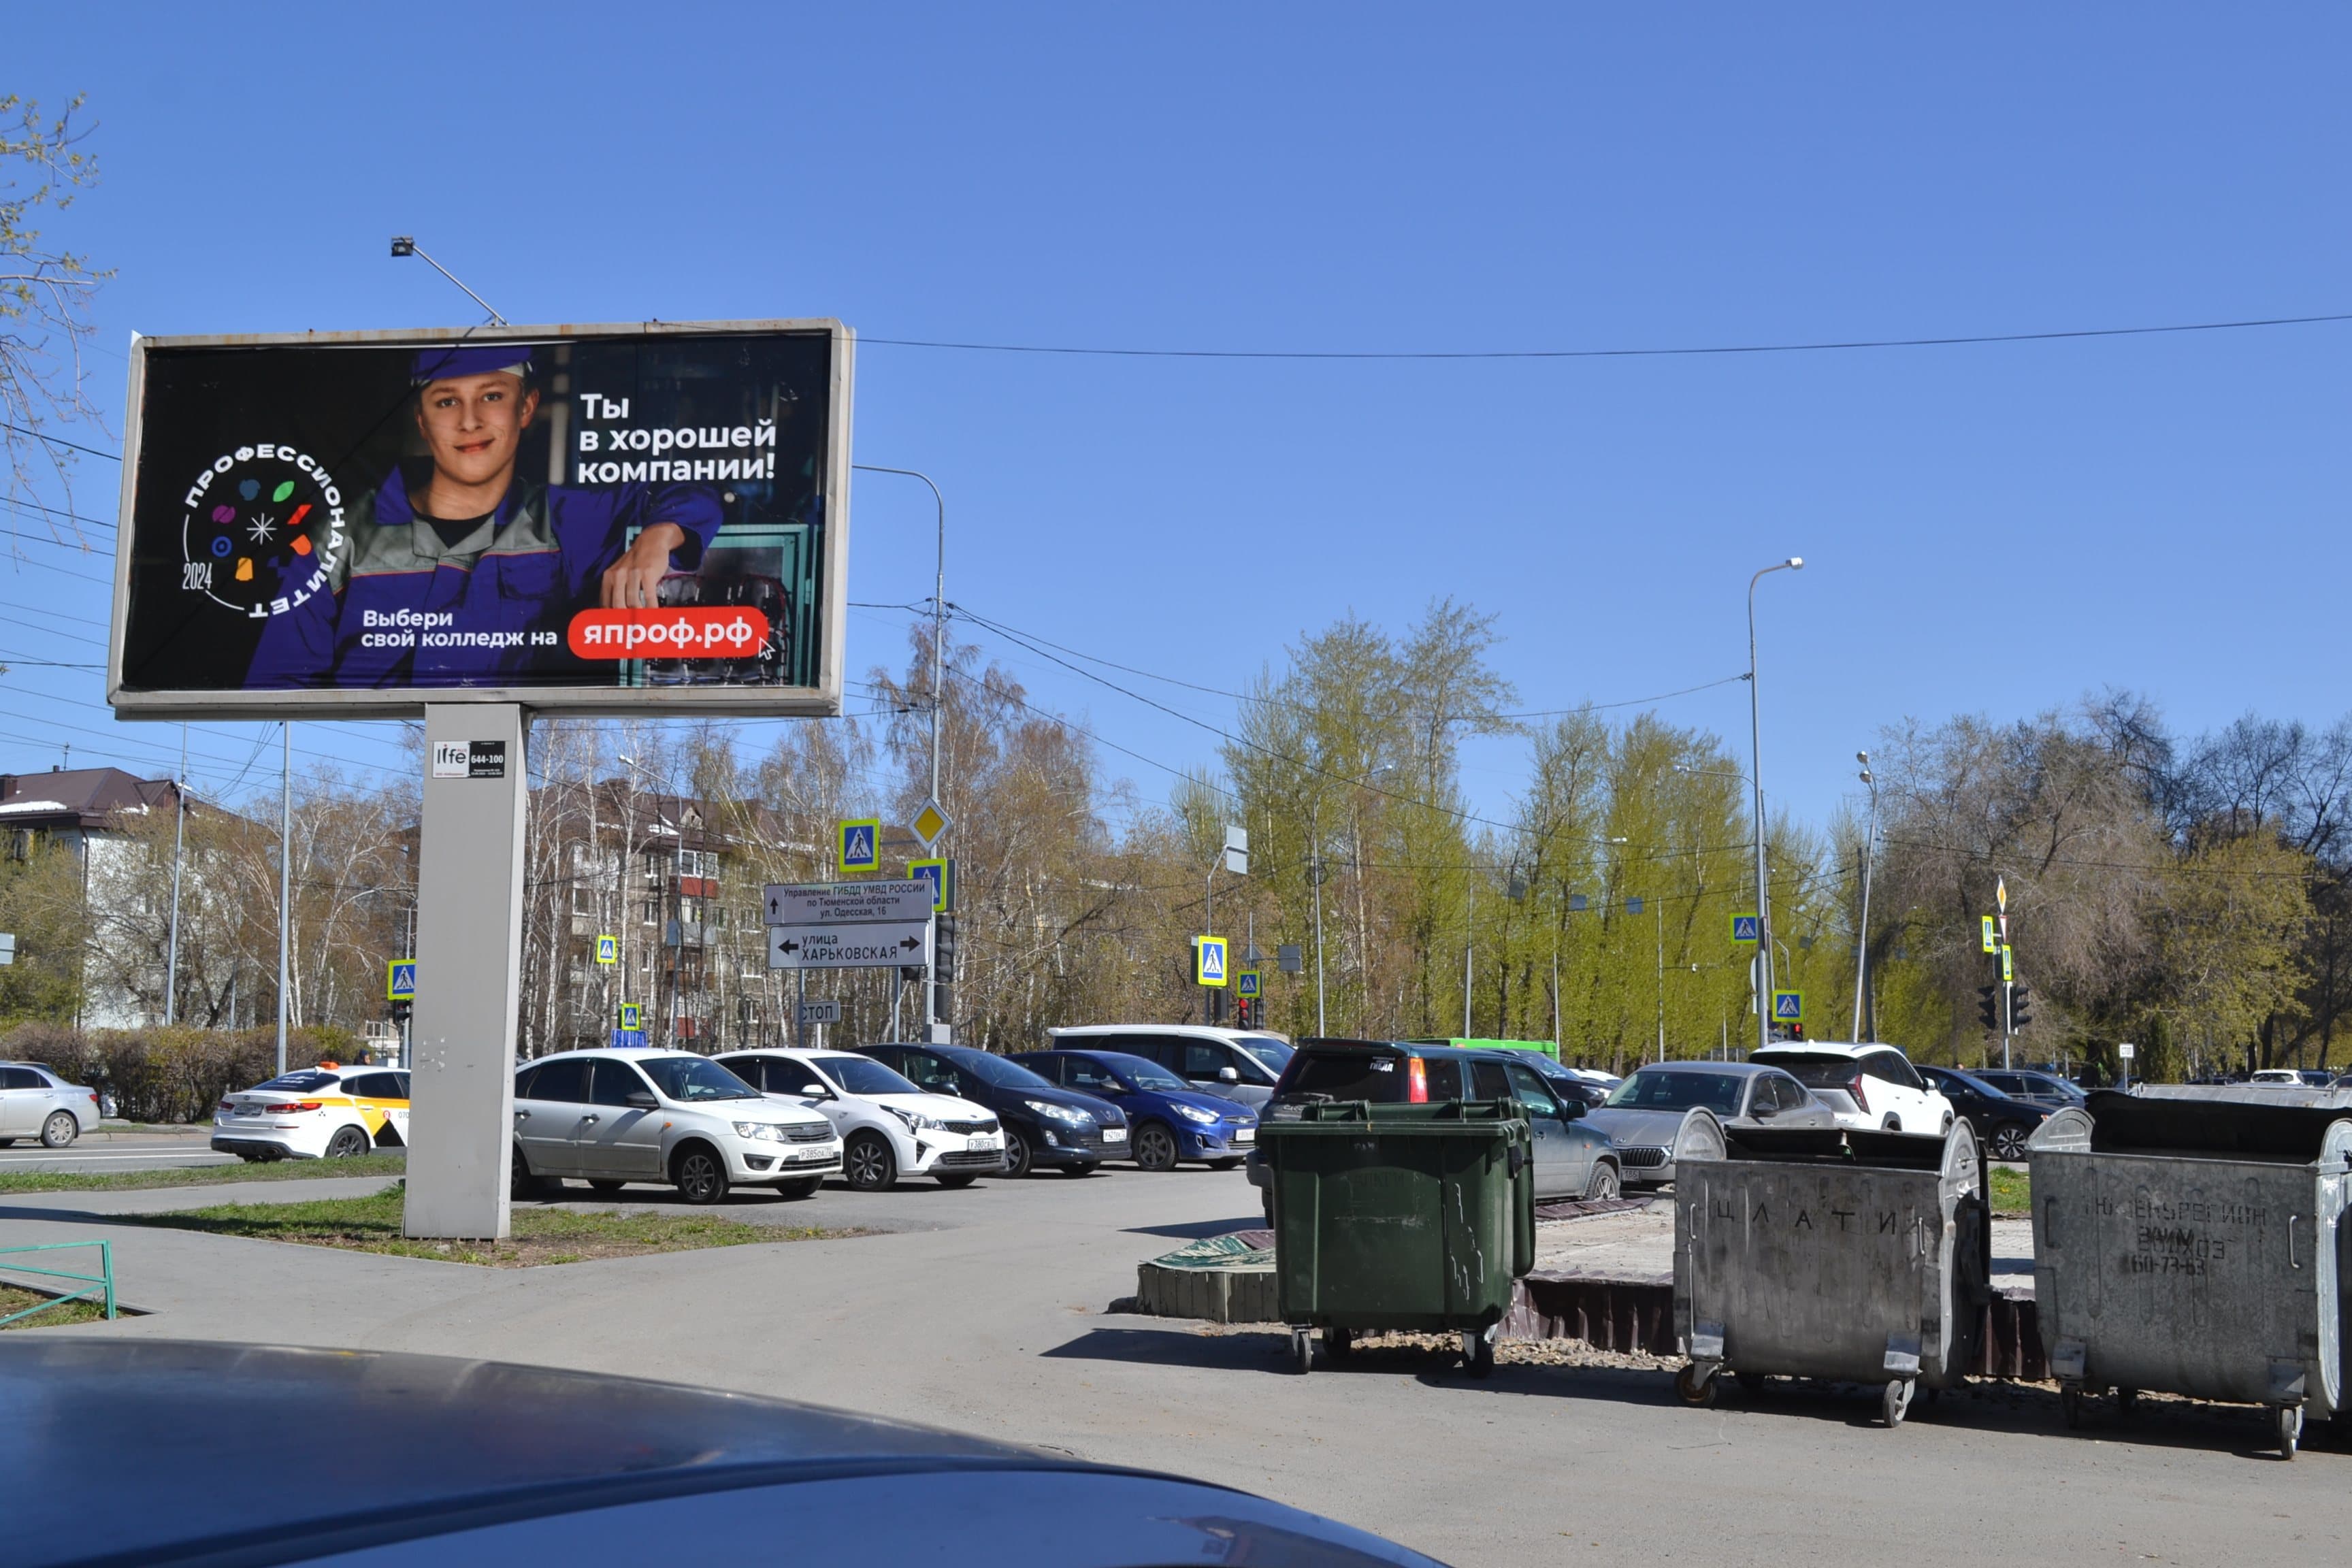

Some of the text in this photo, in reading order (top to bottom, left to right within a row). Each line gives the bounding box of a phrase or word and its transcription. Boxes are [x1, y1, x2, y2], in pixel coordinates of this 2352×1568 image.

[580, 393, 629, 419] Ты
[580, 419, 776, 456] в хорошей
[578, 453, 774, 484] компании!
[184, 444, 345, 618] ПРОФЕССИОНАЛИТЕТ
[182, 562, 212, 589] 2024
[363, 608, 453, 630] Выбери
[361, 628, 557, 648] свой колледж на
[583, 616, 753, 649] япроф.рф
[437, 744, 466, 764] life
[471, 755, 504, 764] 644-100
[783, 883, 926, 899] Управление ГИБДД УМВД РОССИИ
[806, 896, 900, 908] по Тюменской области
[820, 906, 887, 919] ул. Одесская, 16
[802, 935, 838, 947] улица
[802, 947, 898, 961] ХАРЬКОВСКАЯ
